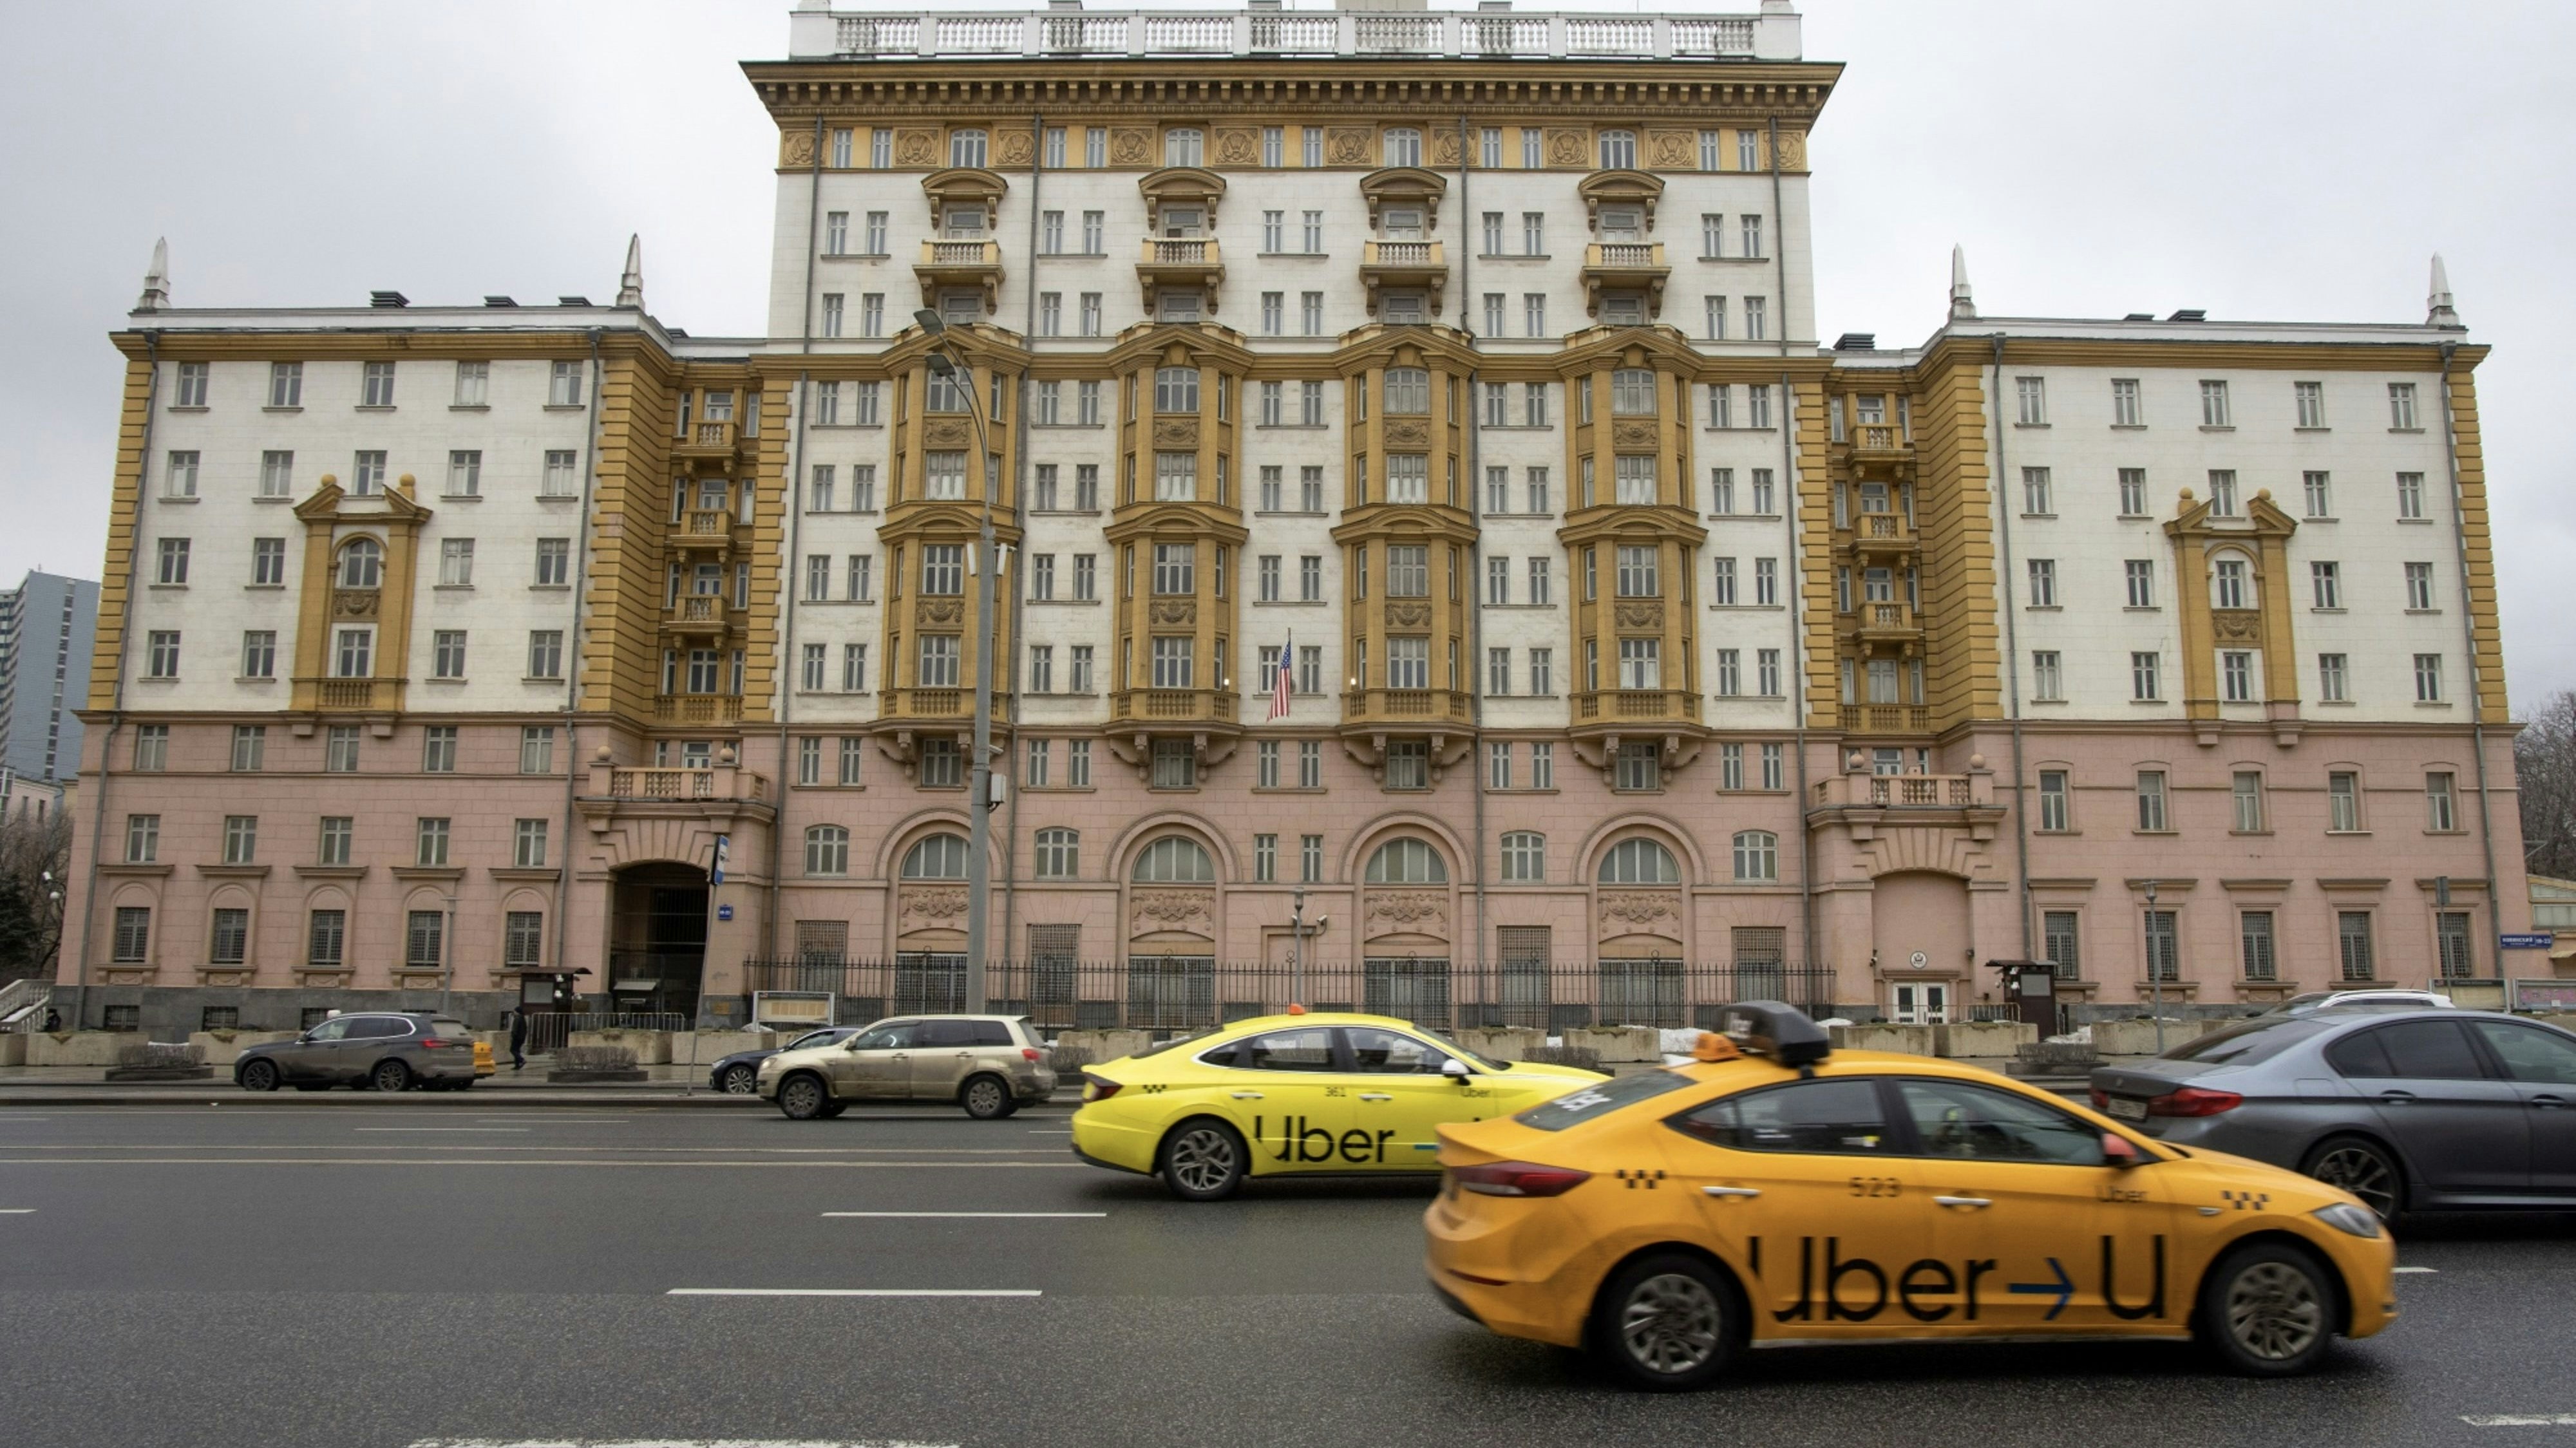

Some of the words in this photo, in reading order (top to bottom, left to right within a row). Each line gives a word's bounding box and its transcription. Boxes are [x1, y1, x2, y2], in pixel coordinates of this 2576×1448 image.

[1461, 1087, 1490, 1098] Uber
[1255, 1115, 1395, 1163] Uber
[1849, 1176, 1903, 1198] 523
[2096, 1185, 2148, 1204] Uber
[1747, 1236, 1998, 1322] Uber
